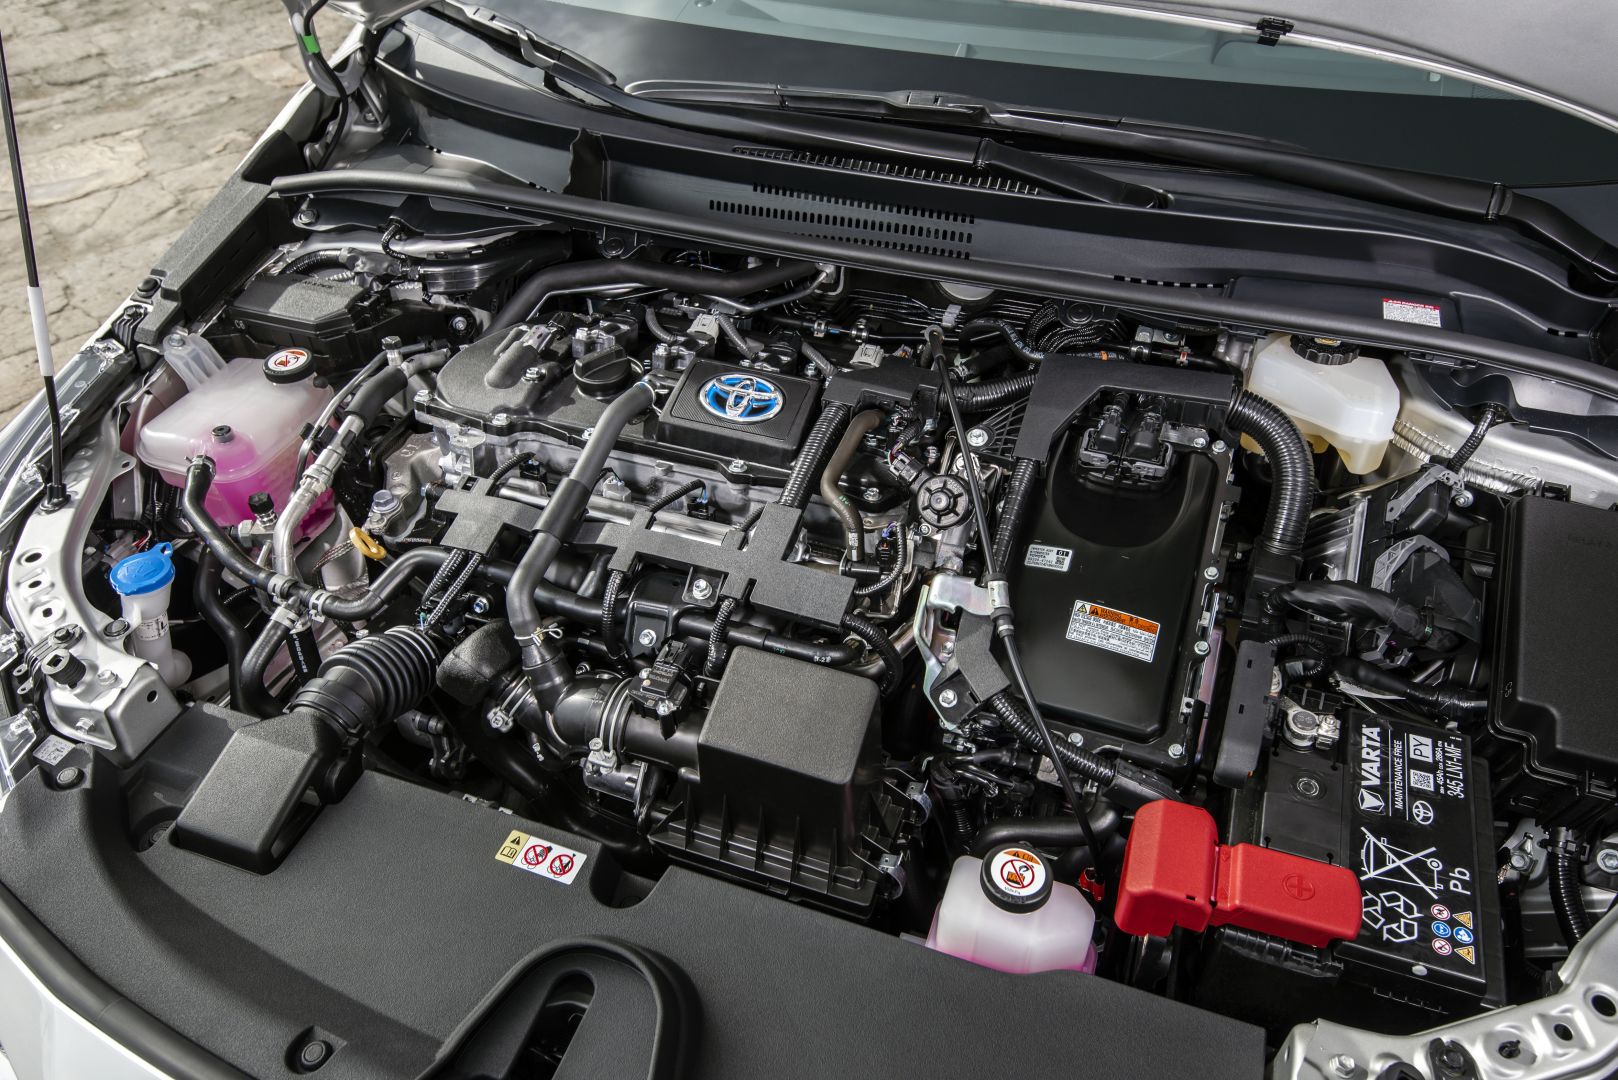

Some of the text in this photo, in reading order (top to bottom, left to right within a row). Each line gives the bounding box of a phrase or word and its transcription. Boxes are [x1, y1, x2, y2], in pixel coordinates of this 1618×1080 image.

[1361, 727, 1380, 786] VARTA
[1412, 737, 1430, 759] PY
[1444, 741, 1463, 779] LN1-MF
[1393, 739, 1403, 810] MAINTENANCE FREE
[1447, 778, 1465, 799] 345
[1449, 867, 1471, 895] Pb
